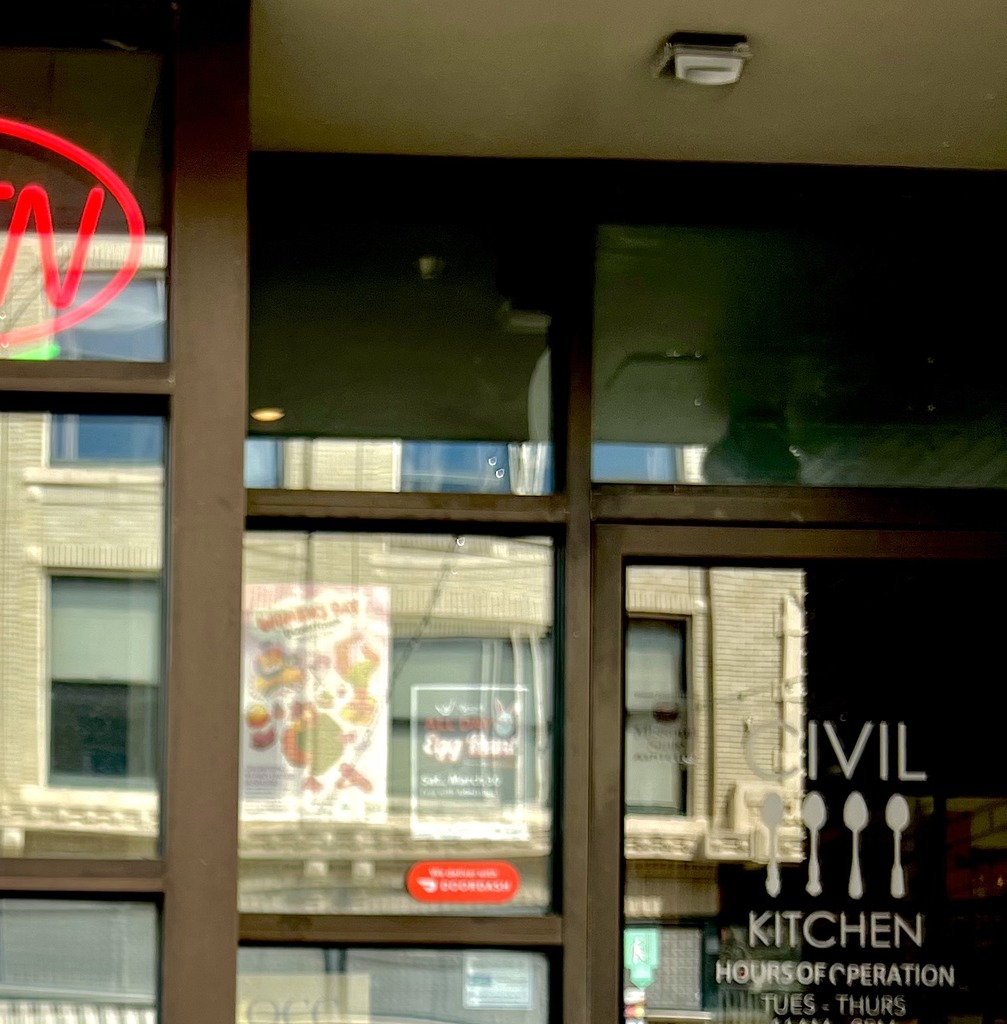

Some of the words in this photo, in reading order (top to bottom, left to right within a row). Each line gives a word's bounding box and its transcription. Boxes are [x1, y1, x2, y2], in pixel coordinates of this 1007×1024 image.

[743, 720, 927, 781] CIVIL
[749, 910, 925, 949] KITCHEN
[716, 960, 792, 984] HOURS
[796, 961, 826, 986] OF
[829, 961, 955, 987] OPERATION
[761, 994, 815, 1015] TUES
[835, 994, 906, 1016] THURS
